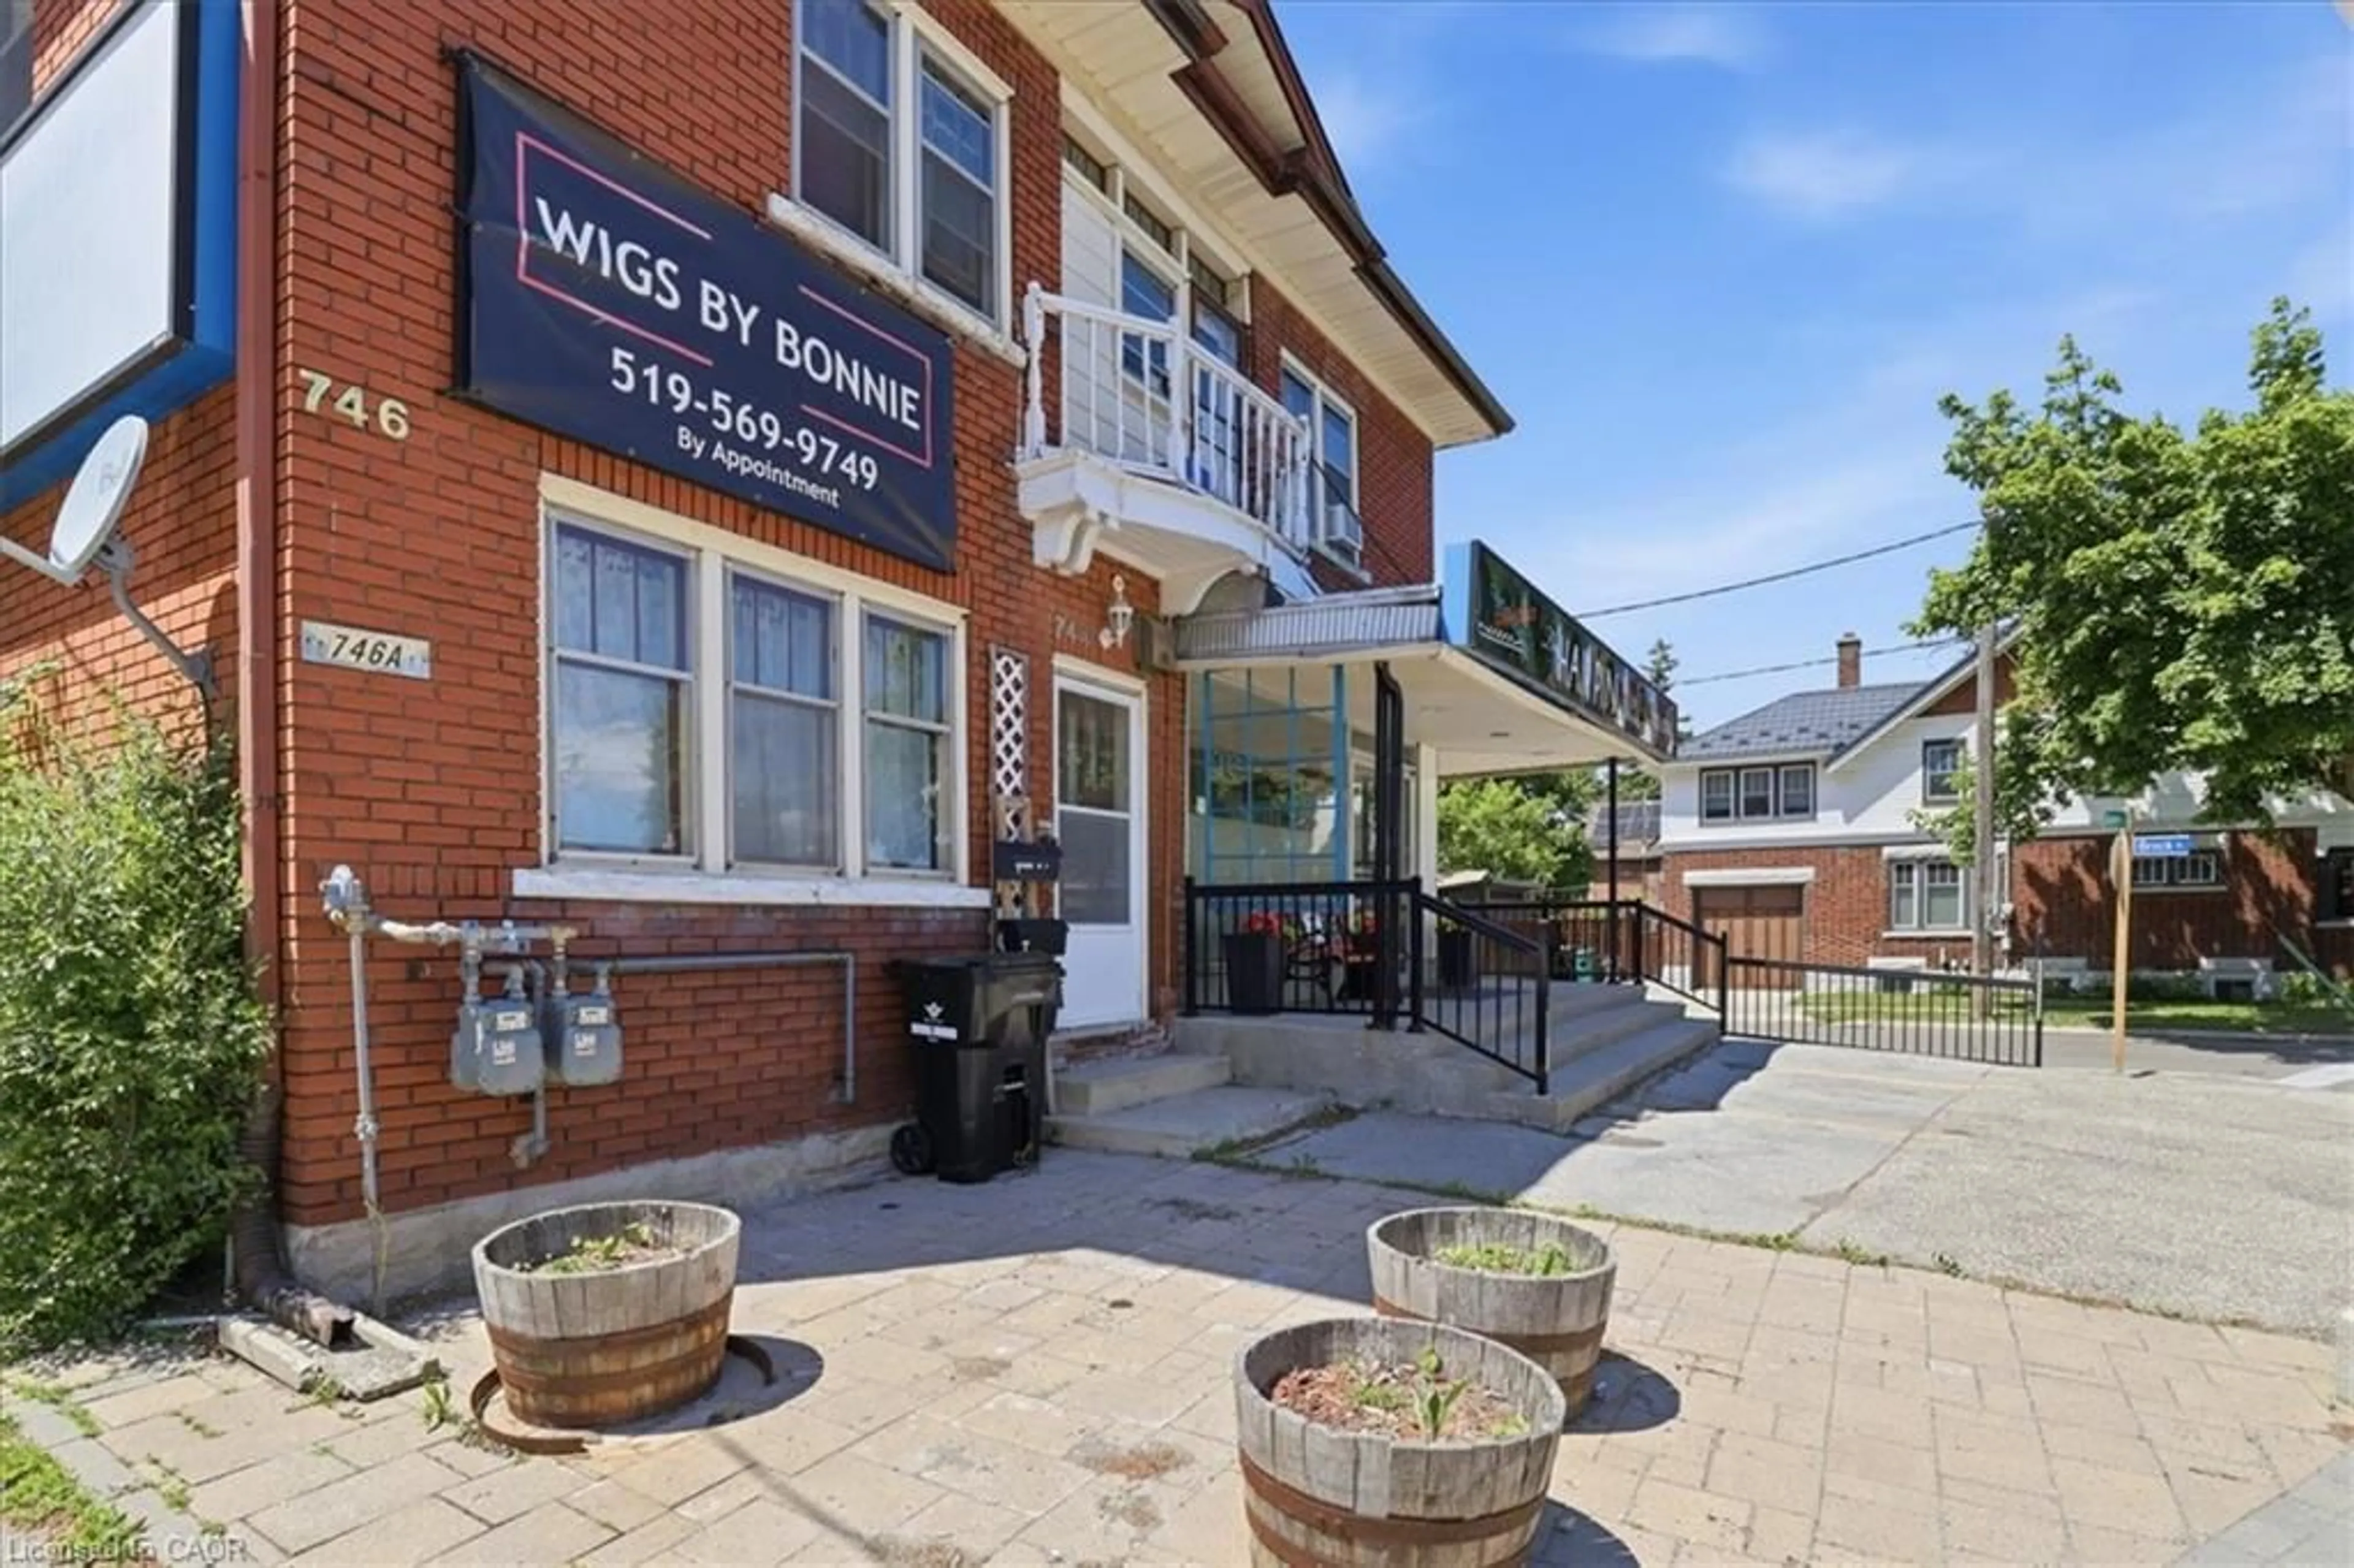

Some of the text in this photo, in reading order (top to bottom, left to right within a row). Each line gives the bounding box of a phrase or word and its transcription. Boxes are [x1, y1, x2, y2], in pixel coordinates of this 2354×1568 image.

[536, 197, 921, 430] WIGS BY BONNIE
[299, 368, 409, 440] 746
[611, 348, 878, 490] 519-569-9749
[677, 425, 840, 509] By Appointment
[332, 635, 402, 669] 746A
